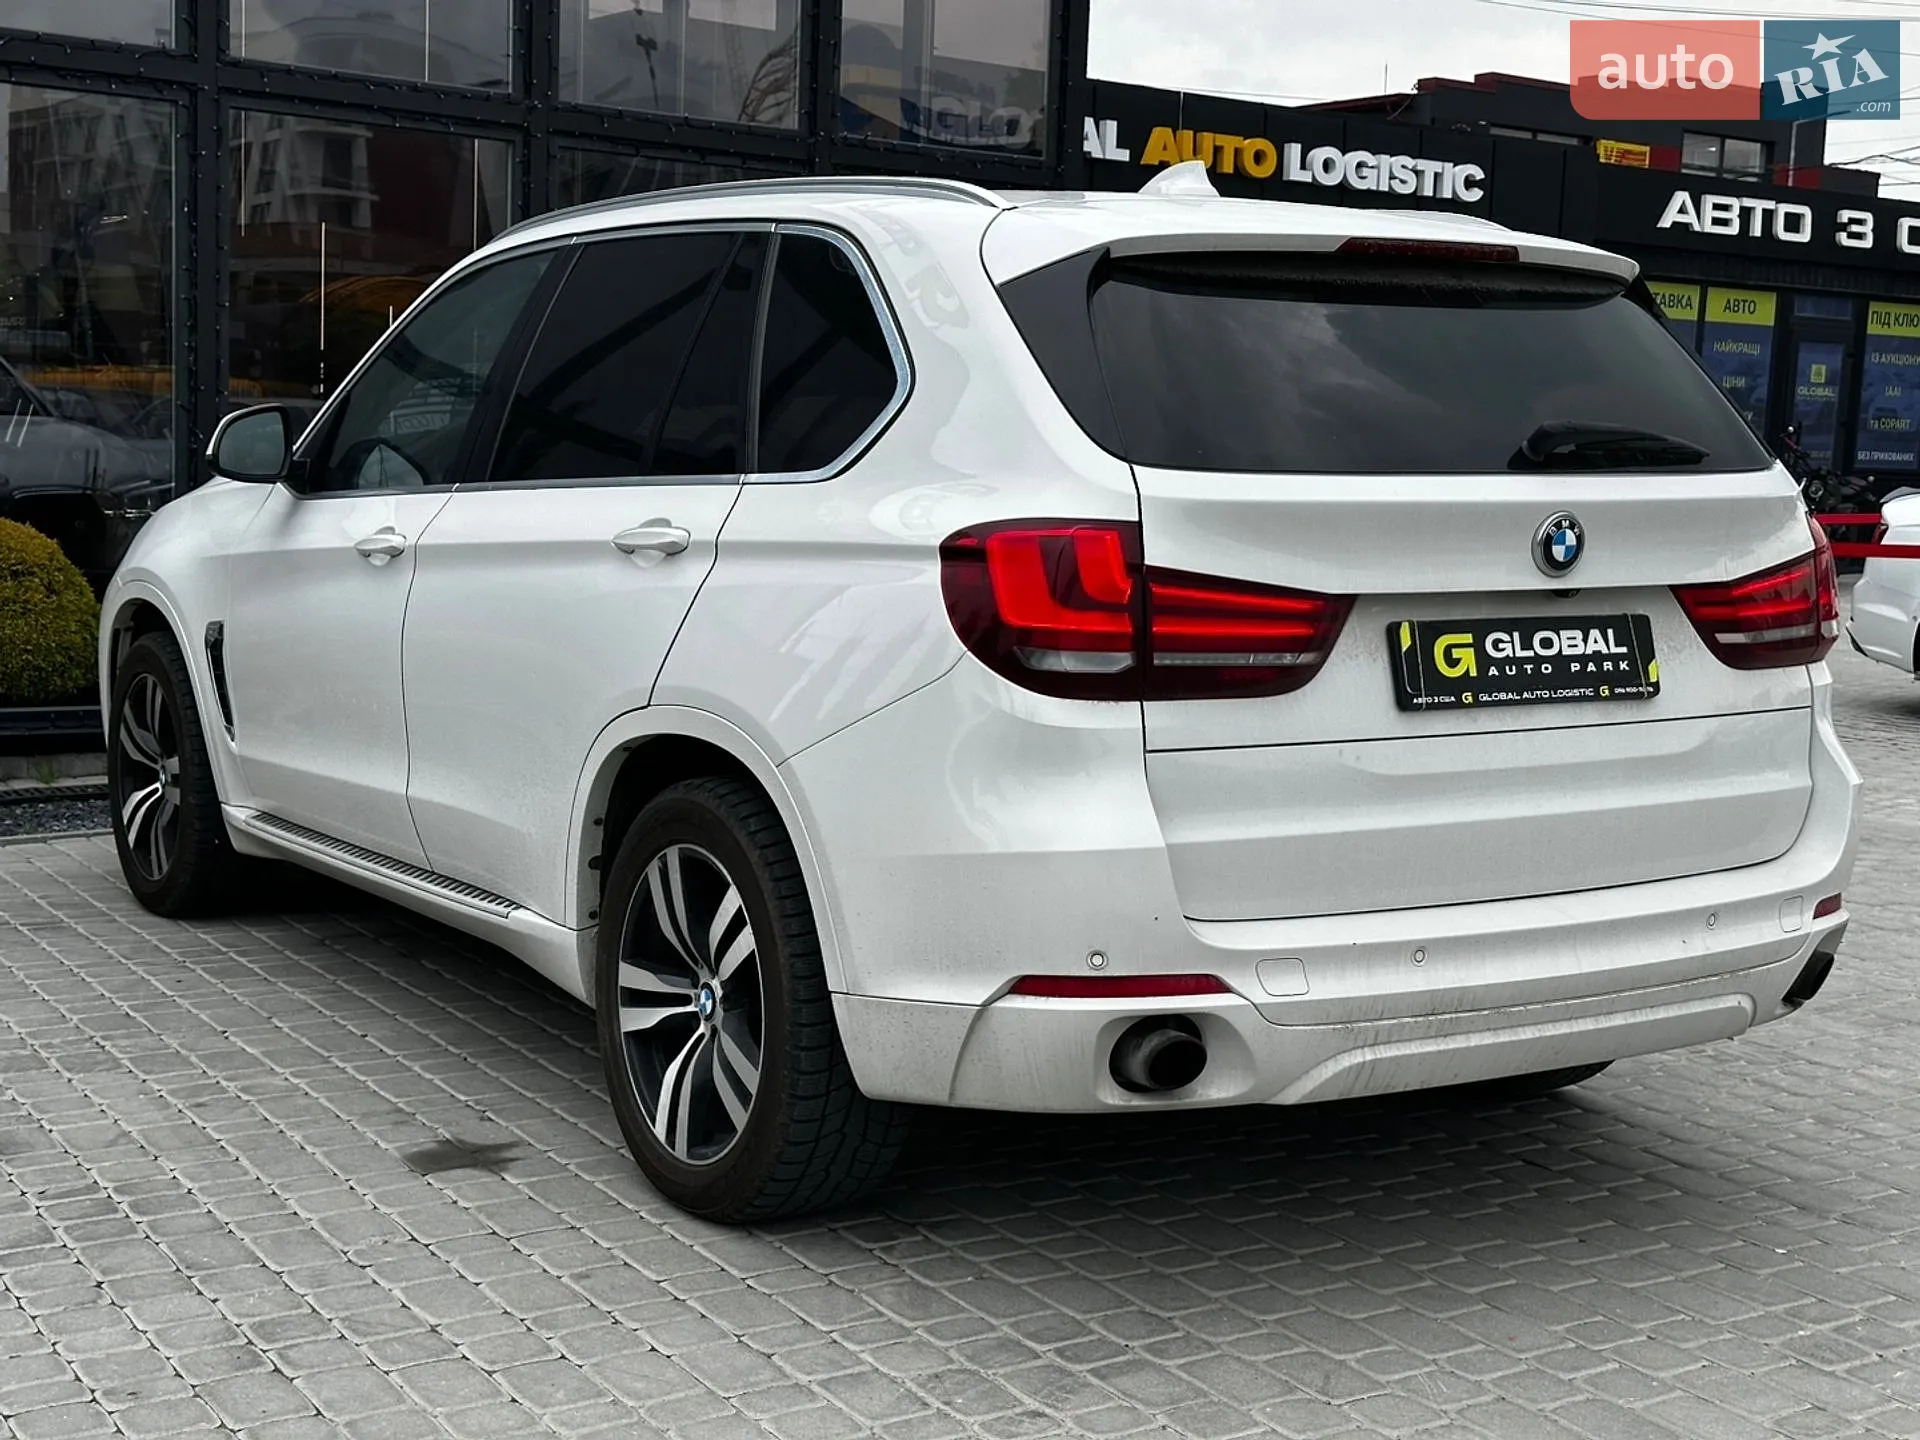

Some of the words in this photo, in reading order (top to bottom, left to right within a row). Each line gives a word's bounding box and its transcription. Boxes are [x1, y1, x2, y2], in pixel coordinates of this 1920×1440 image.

[1140, 126, 1278, 178] AUTO
[1282, 142, 1486, 203] LOGISTIC
[1656, 190, 1813, 243] АВТО
[1723, 298, 1757, 315] АВТО
[1870, 310, 1891, 328] ПІД
[1484, 628, 1628, 658] GLOBAL
[1487, 663, 1553, 676] AUTO
[1570, 660, 1630, 673] PARK
[1478, 691, 1521, 702] GLOBAL
[1522, 689, 1550, 700] AUTO
[1551, 687, 1595, 698] LOGISTIC
